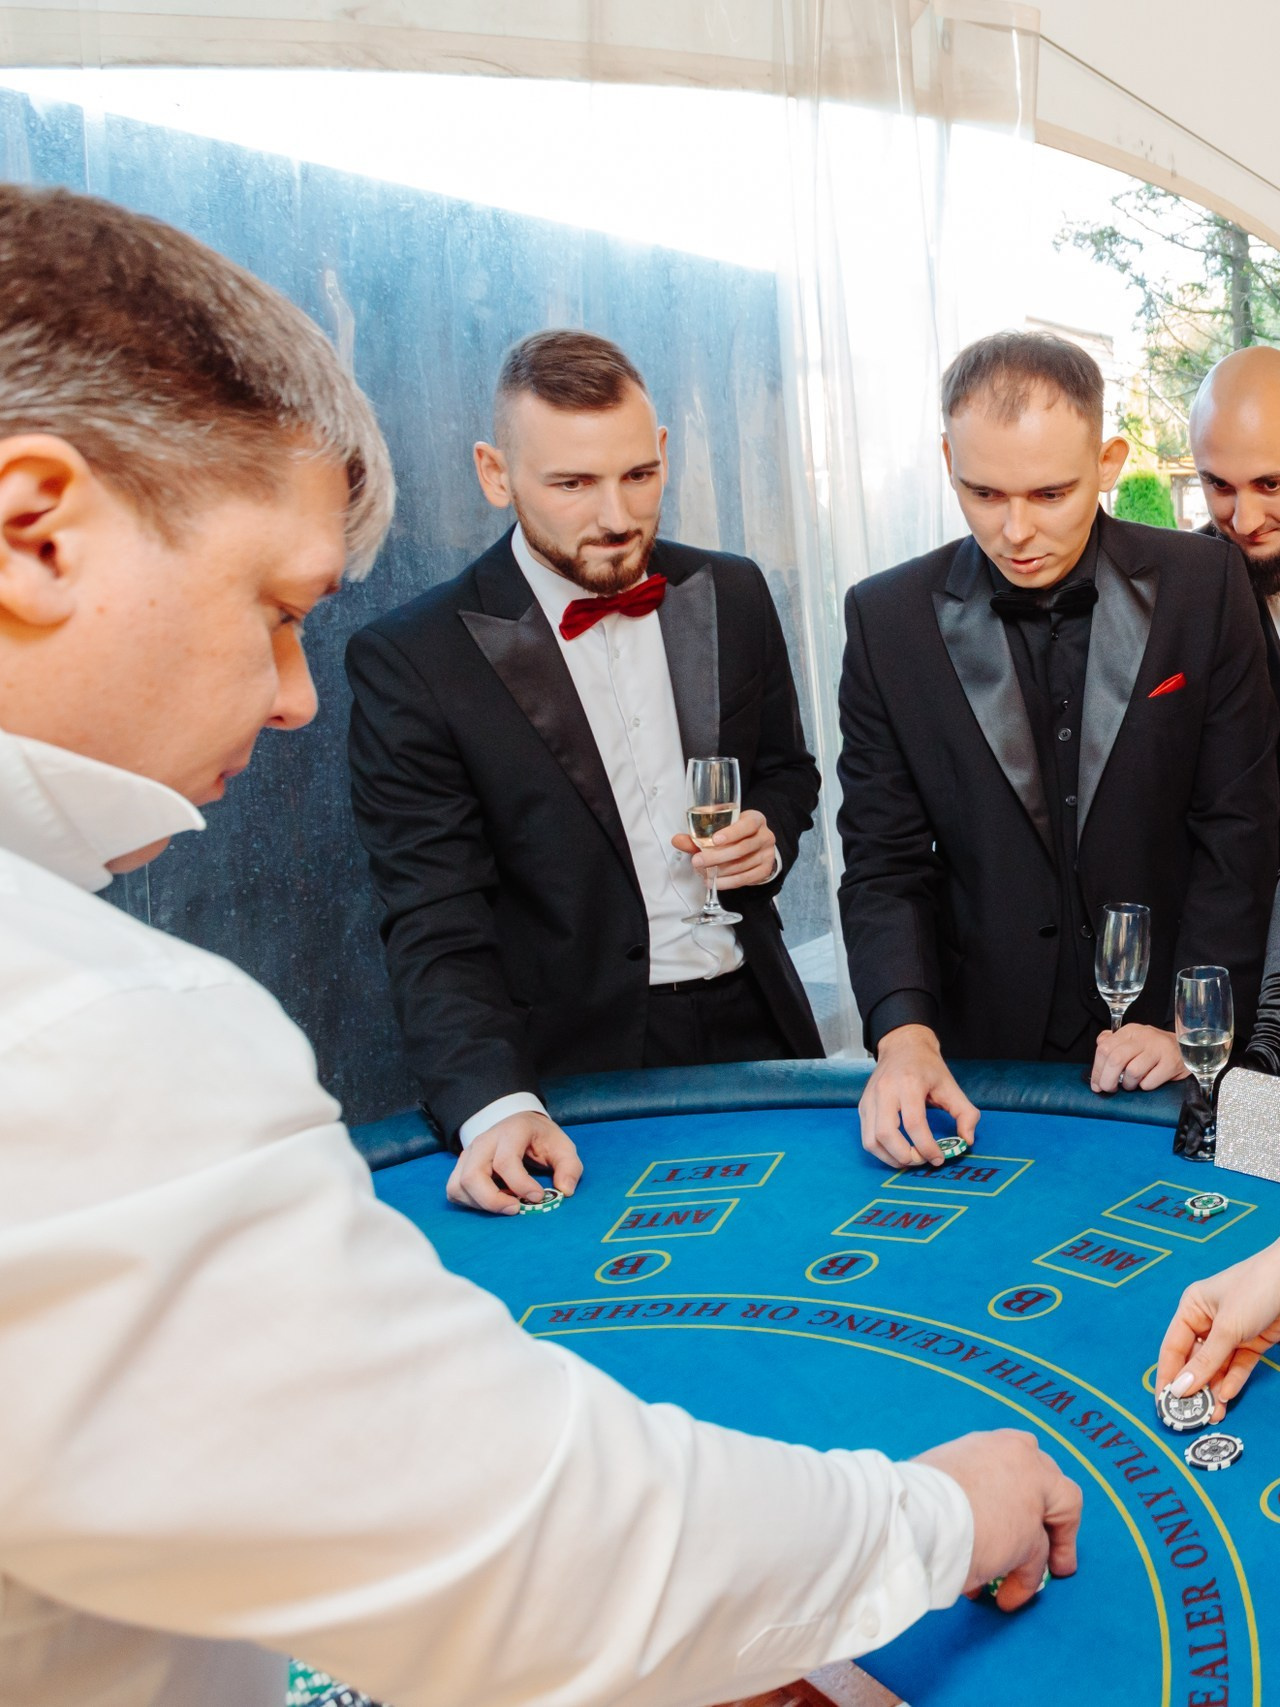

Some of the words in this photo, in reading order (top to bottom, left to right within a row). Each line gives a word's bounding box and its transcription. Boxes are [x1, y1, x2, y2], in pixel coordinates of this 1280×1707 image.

[653, 1162, 751, 1183] BET
[910, 1164, 1002, 1183] BET
[619, 1208, 716, 1230] ANTE
[854, 1208, 944, 1231] ANTE
[607, 1255, 648, 1277] B
[818, 1256, 865, 1278] B
[1059, 1239, 1147, 1272] ANTE
[547, 1302, 728, 1323] HIGHER
[740, 1303, 800, 1320] OR
[1002, 1288, 1053, 1315] B
[806, 1309, 992, 1363] ACE/KING
[984, 1358, 1077, 1414] WITH
[1069, 1410, 1161, 1484] PLAYS
[1137, 1486, 1209, 1570] ONLY
[1181, 1577, 1230, 1707] EALER
